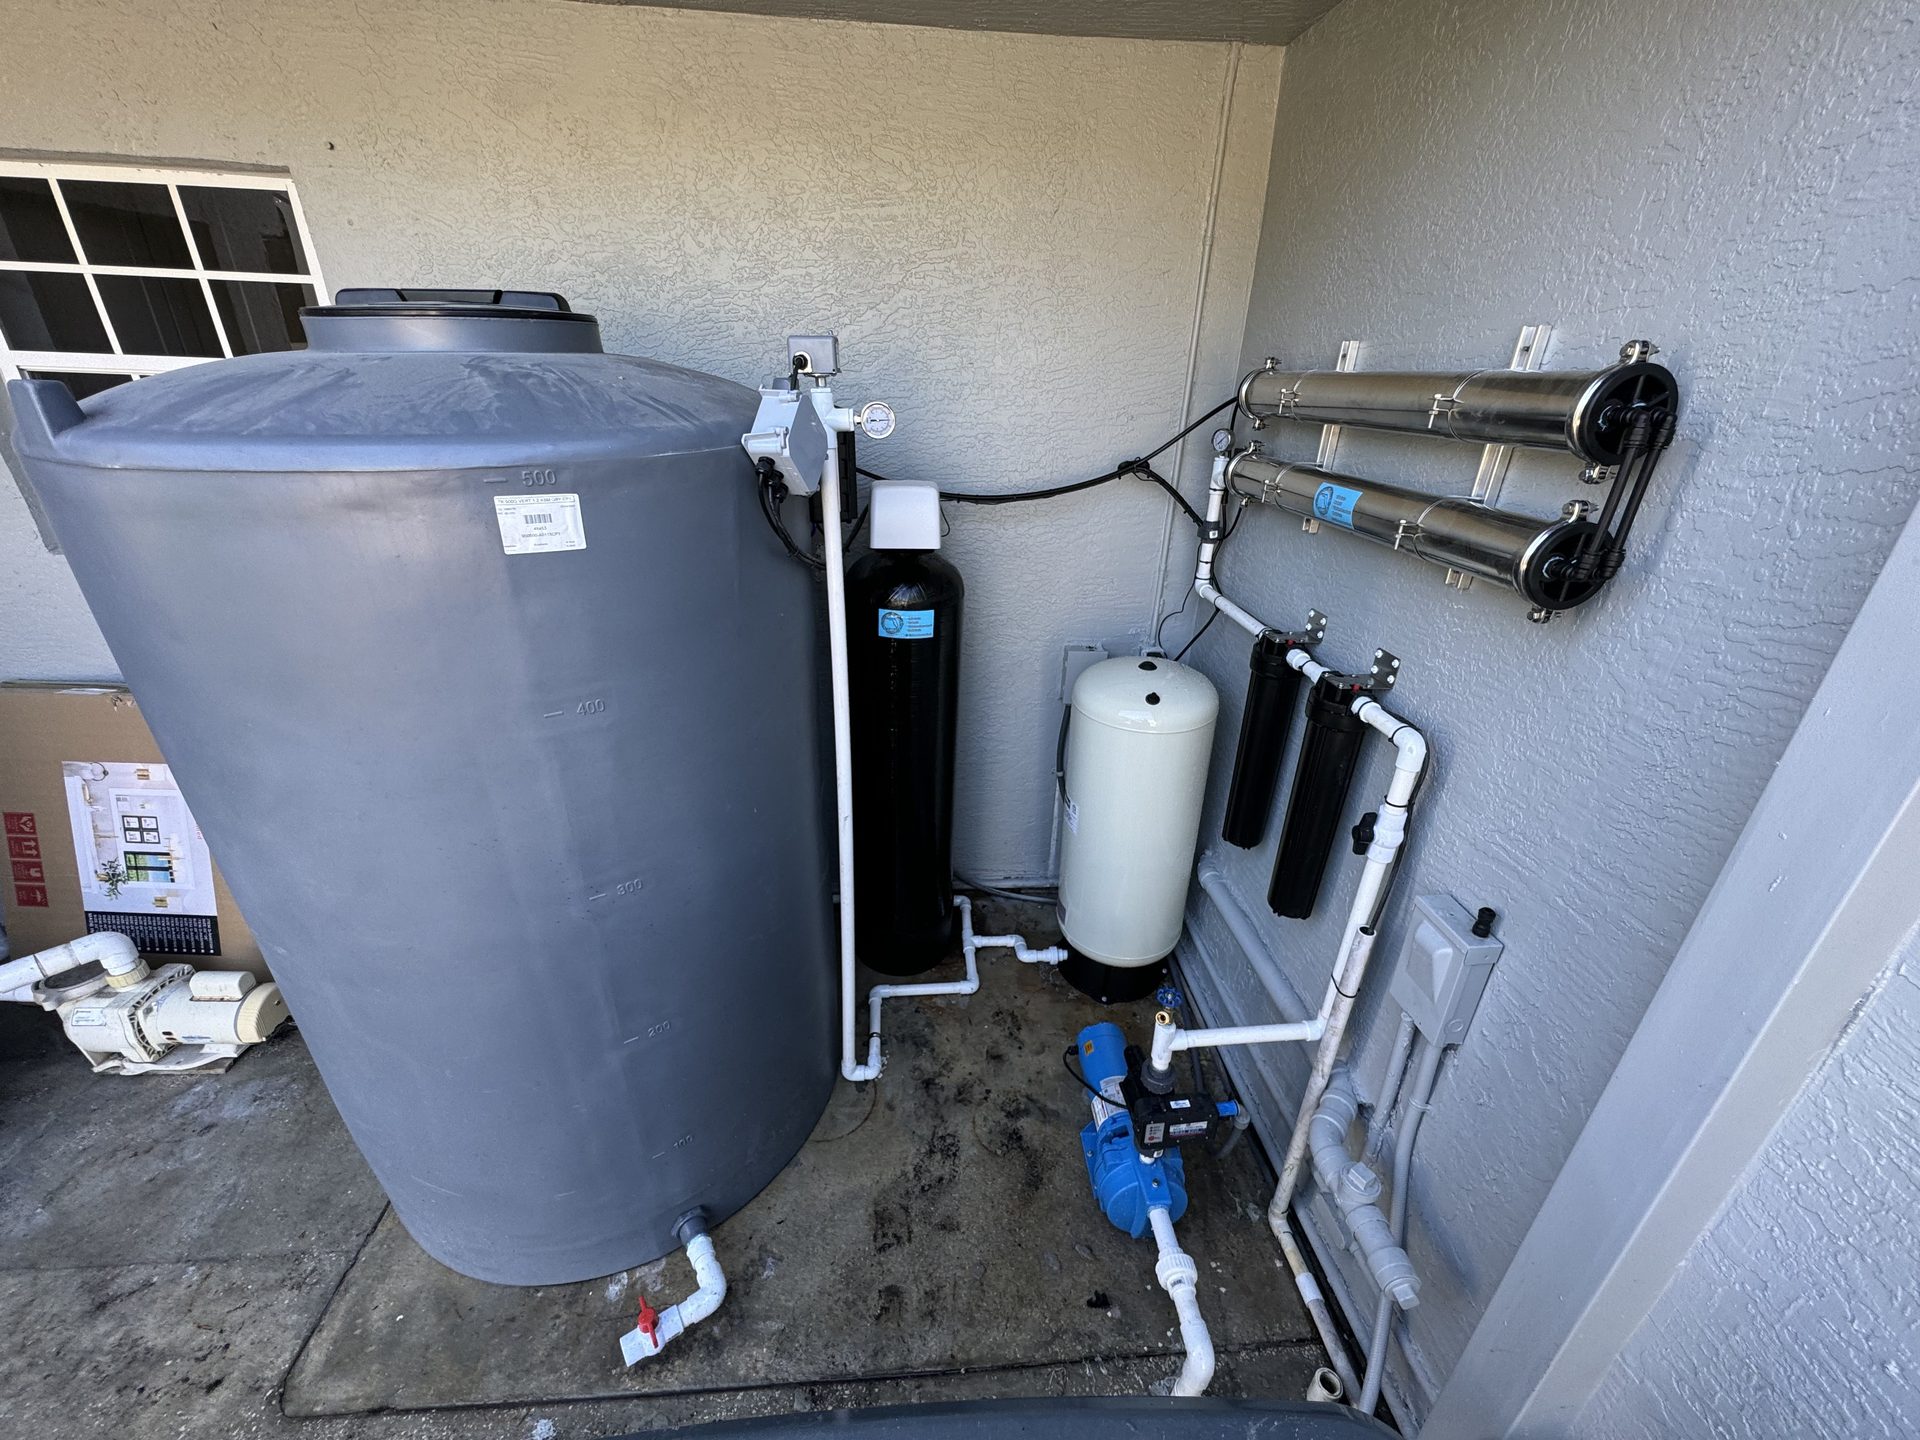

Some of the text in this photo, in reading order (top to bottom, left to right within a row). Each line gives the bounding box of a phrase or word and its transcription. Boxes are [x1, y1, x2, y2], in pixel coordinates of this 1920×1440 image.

[522, 469, 556, 487] 500
[576, 698, 606, 716] 400
[616, 878, 643, 896] 300
[647, 1020, 671, 1038] 200
